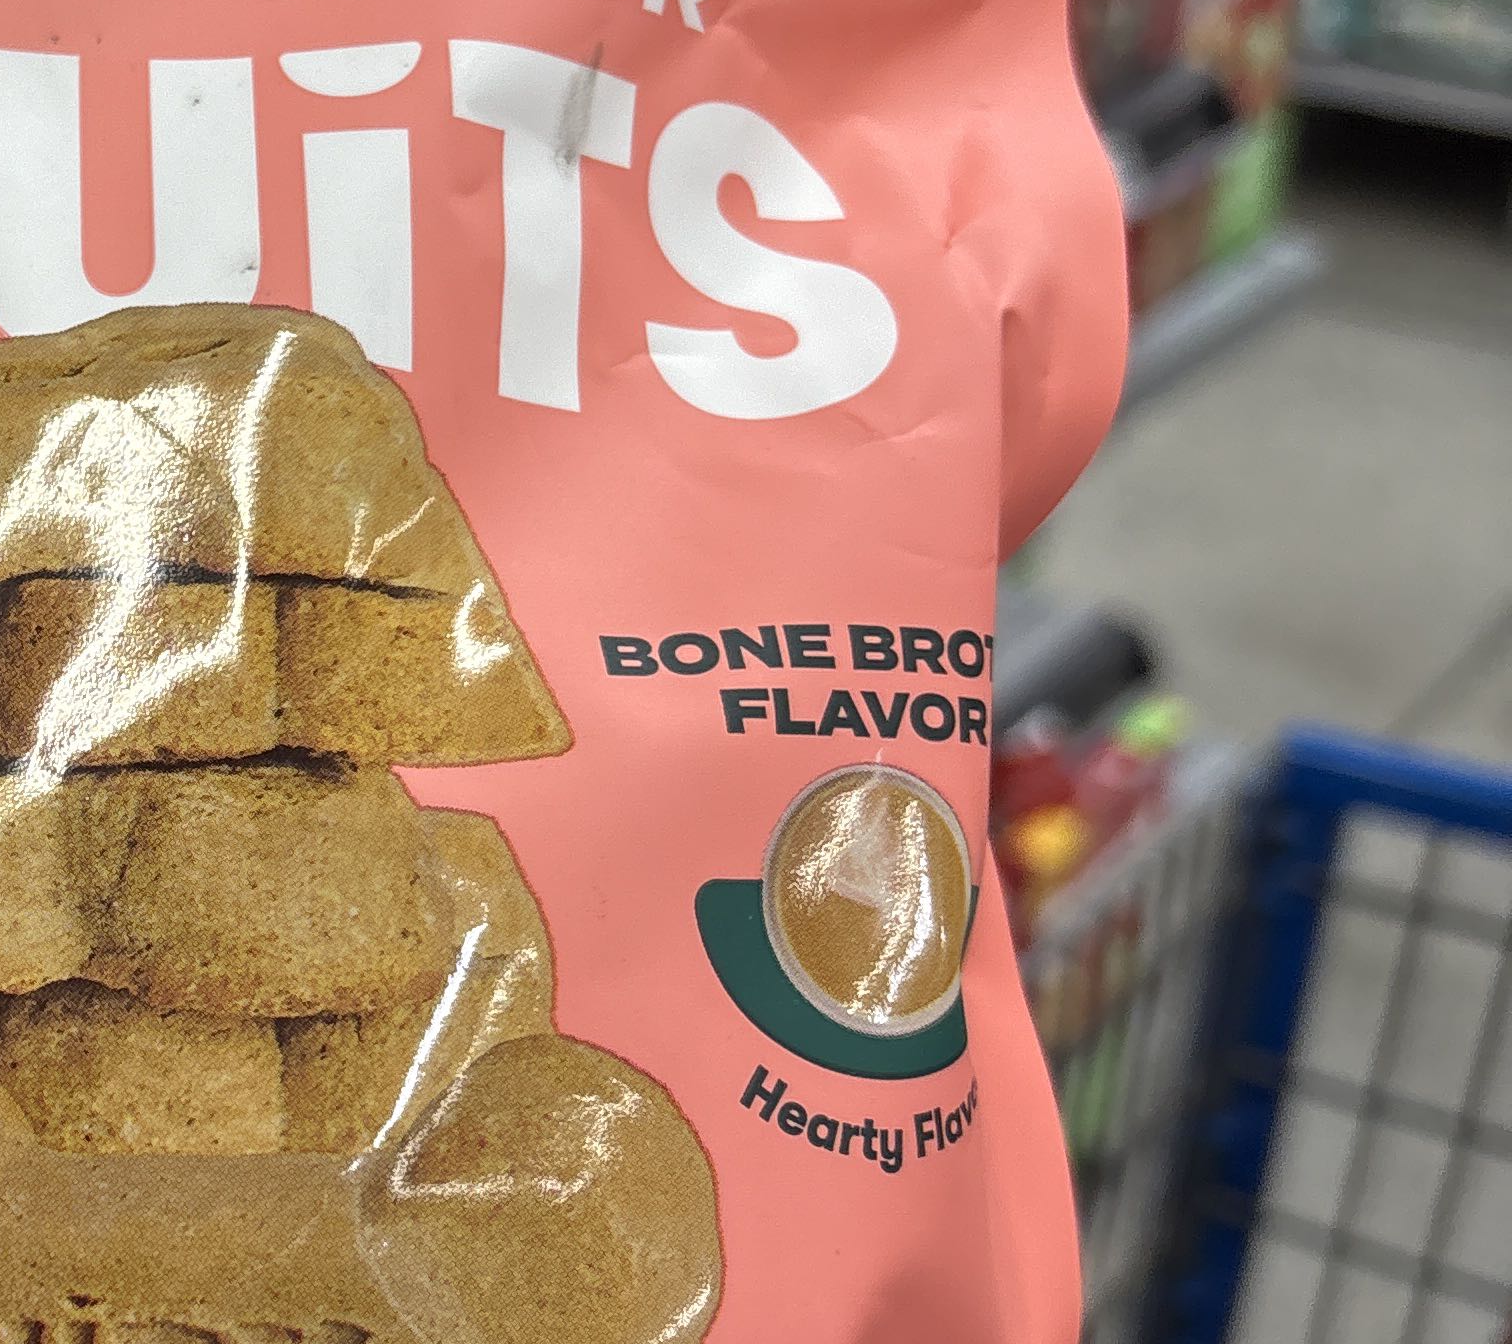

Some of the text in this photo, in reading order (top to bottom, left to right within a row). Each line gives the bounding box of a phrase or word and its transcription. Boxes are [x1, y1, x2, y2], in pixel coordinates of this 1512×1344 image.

[598, 623, 837, 677] BONE
[719, 687, 988, 747] FLAVOR
[739, 1064, 904, 1174] Hearty
